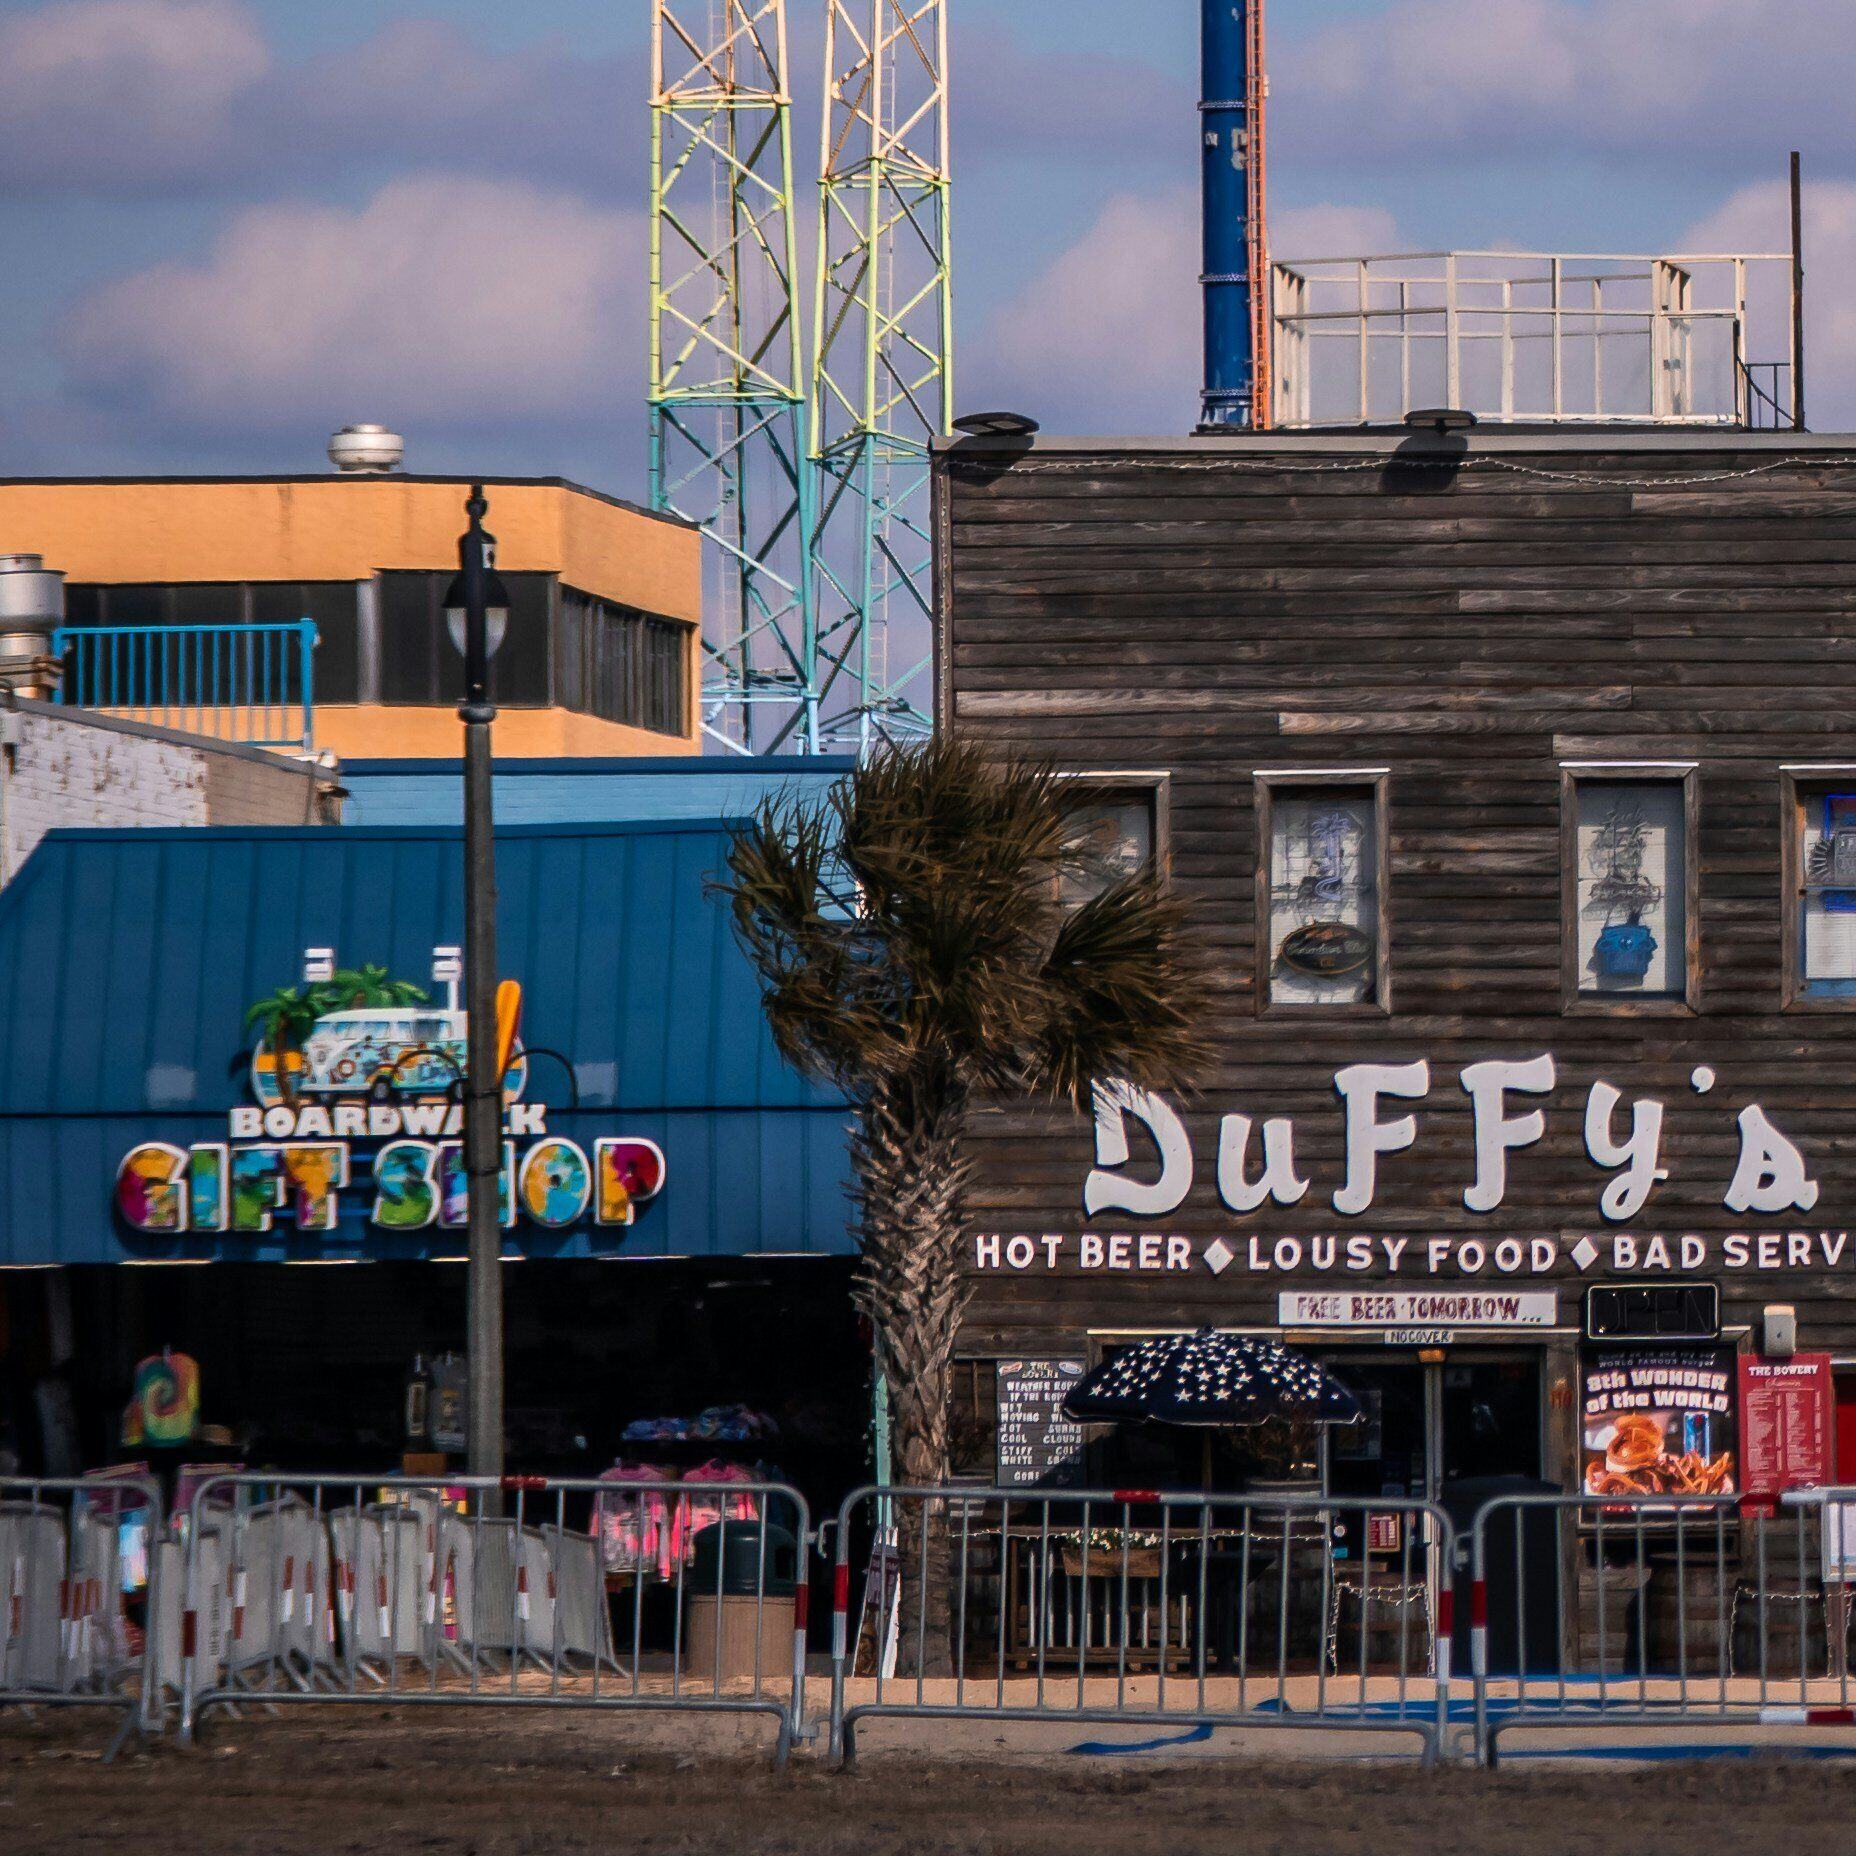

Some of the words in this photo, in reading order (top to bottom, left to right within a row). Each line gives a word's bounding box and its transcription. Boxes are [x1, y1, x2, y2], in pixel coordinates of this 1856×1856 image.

[229, 1104, 546, 1135] BOARDWK
[117, 1141, 349, 1231] GIFT
[975, 1234, 1063, 1269] HOT
[1080, 1235, 1190, 1270] BEER
[1249, 1236, 1407, 1271] LOUSY
[1427, 1238, 1557, 1273] FOOD
[1613, 1234, 1705, 1270] BAD
[1297, 1296, 1341, 1320] FREE
[1350, 1295, 1397, 1320] BEER
[1587, 1371, 1626, 1392] 8th
[1630, 1369, 1729, 1392] WONDER
[1748, 1366, 1771, 1376] THE
[1773, 1364, 1818, 1376] BOWERY
[1586, 1393, 1609, 1413] of
[1612, 1390, 1650, 1408] the
[1653, 1390, 1729, 1412] WORLD
